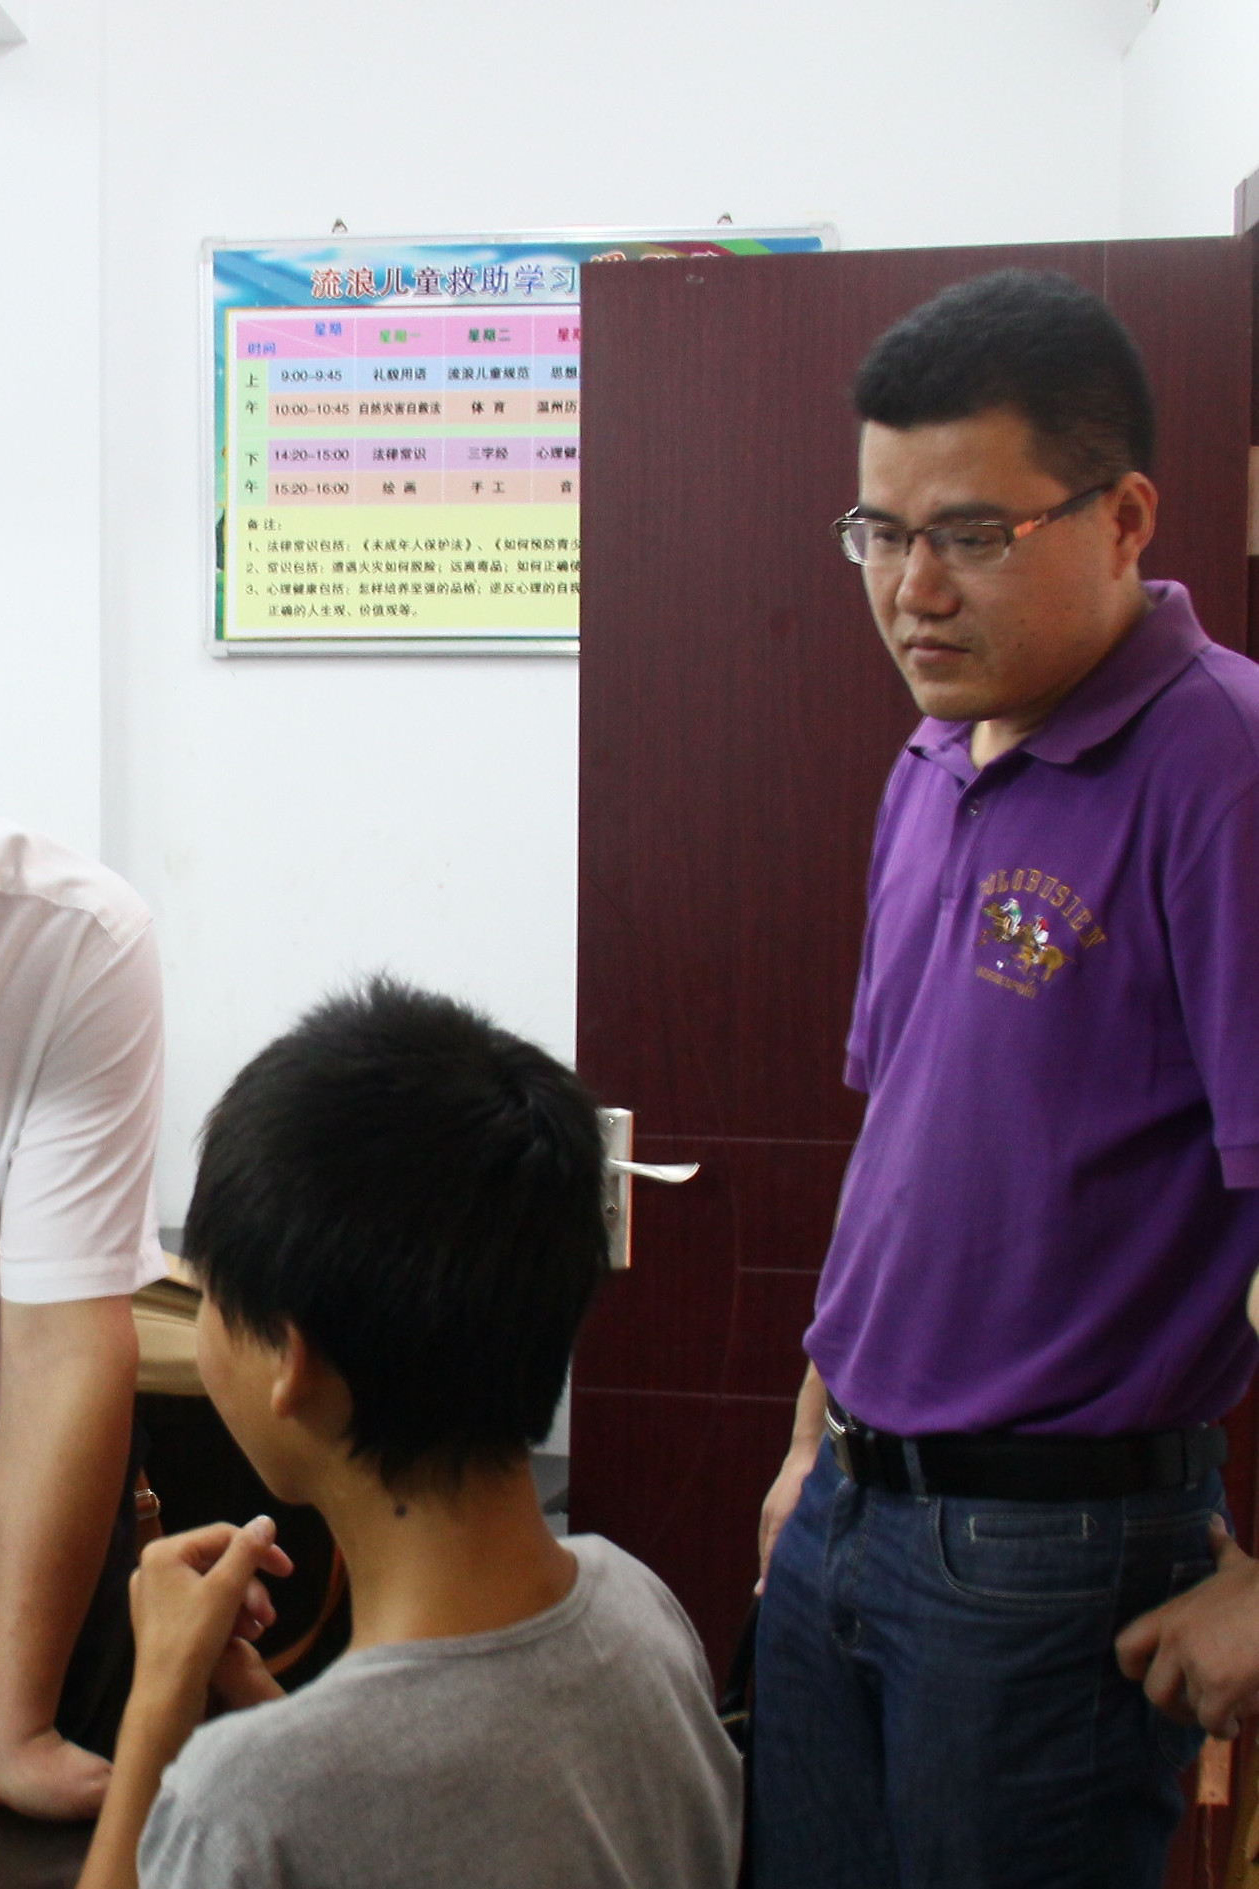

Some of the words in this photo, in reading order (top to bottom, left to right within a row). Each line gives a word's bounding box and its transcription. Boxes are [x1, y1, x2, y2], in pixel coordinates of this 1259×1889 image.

[310, 264, 578, 299] 流浪儿童救助学习
[315, 322, 342, 336] 星期
[380, 329, 421, 343] 星期一
[468, 328, 511, 342] 星期二
[248, 342, 276, 355] 时间
[374, 368, 427, 381] 礼貌用语
[448, 366, 530, 380] 流浪儿童规范
[373, 447, 426, 461] 法律常识
[468, 446, 508, 460] 三字经
[561, 480, 572, 493] 音
